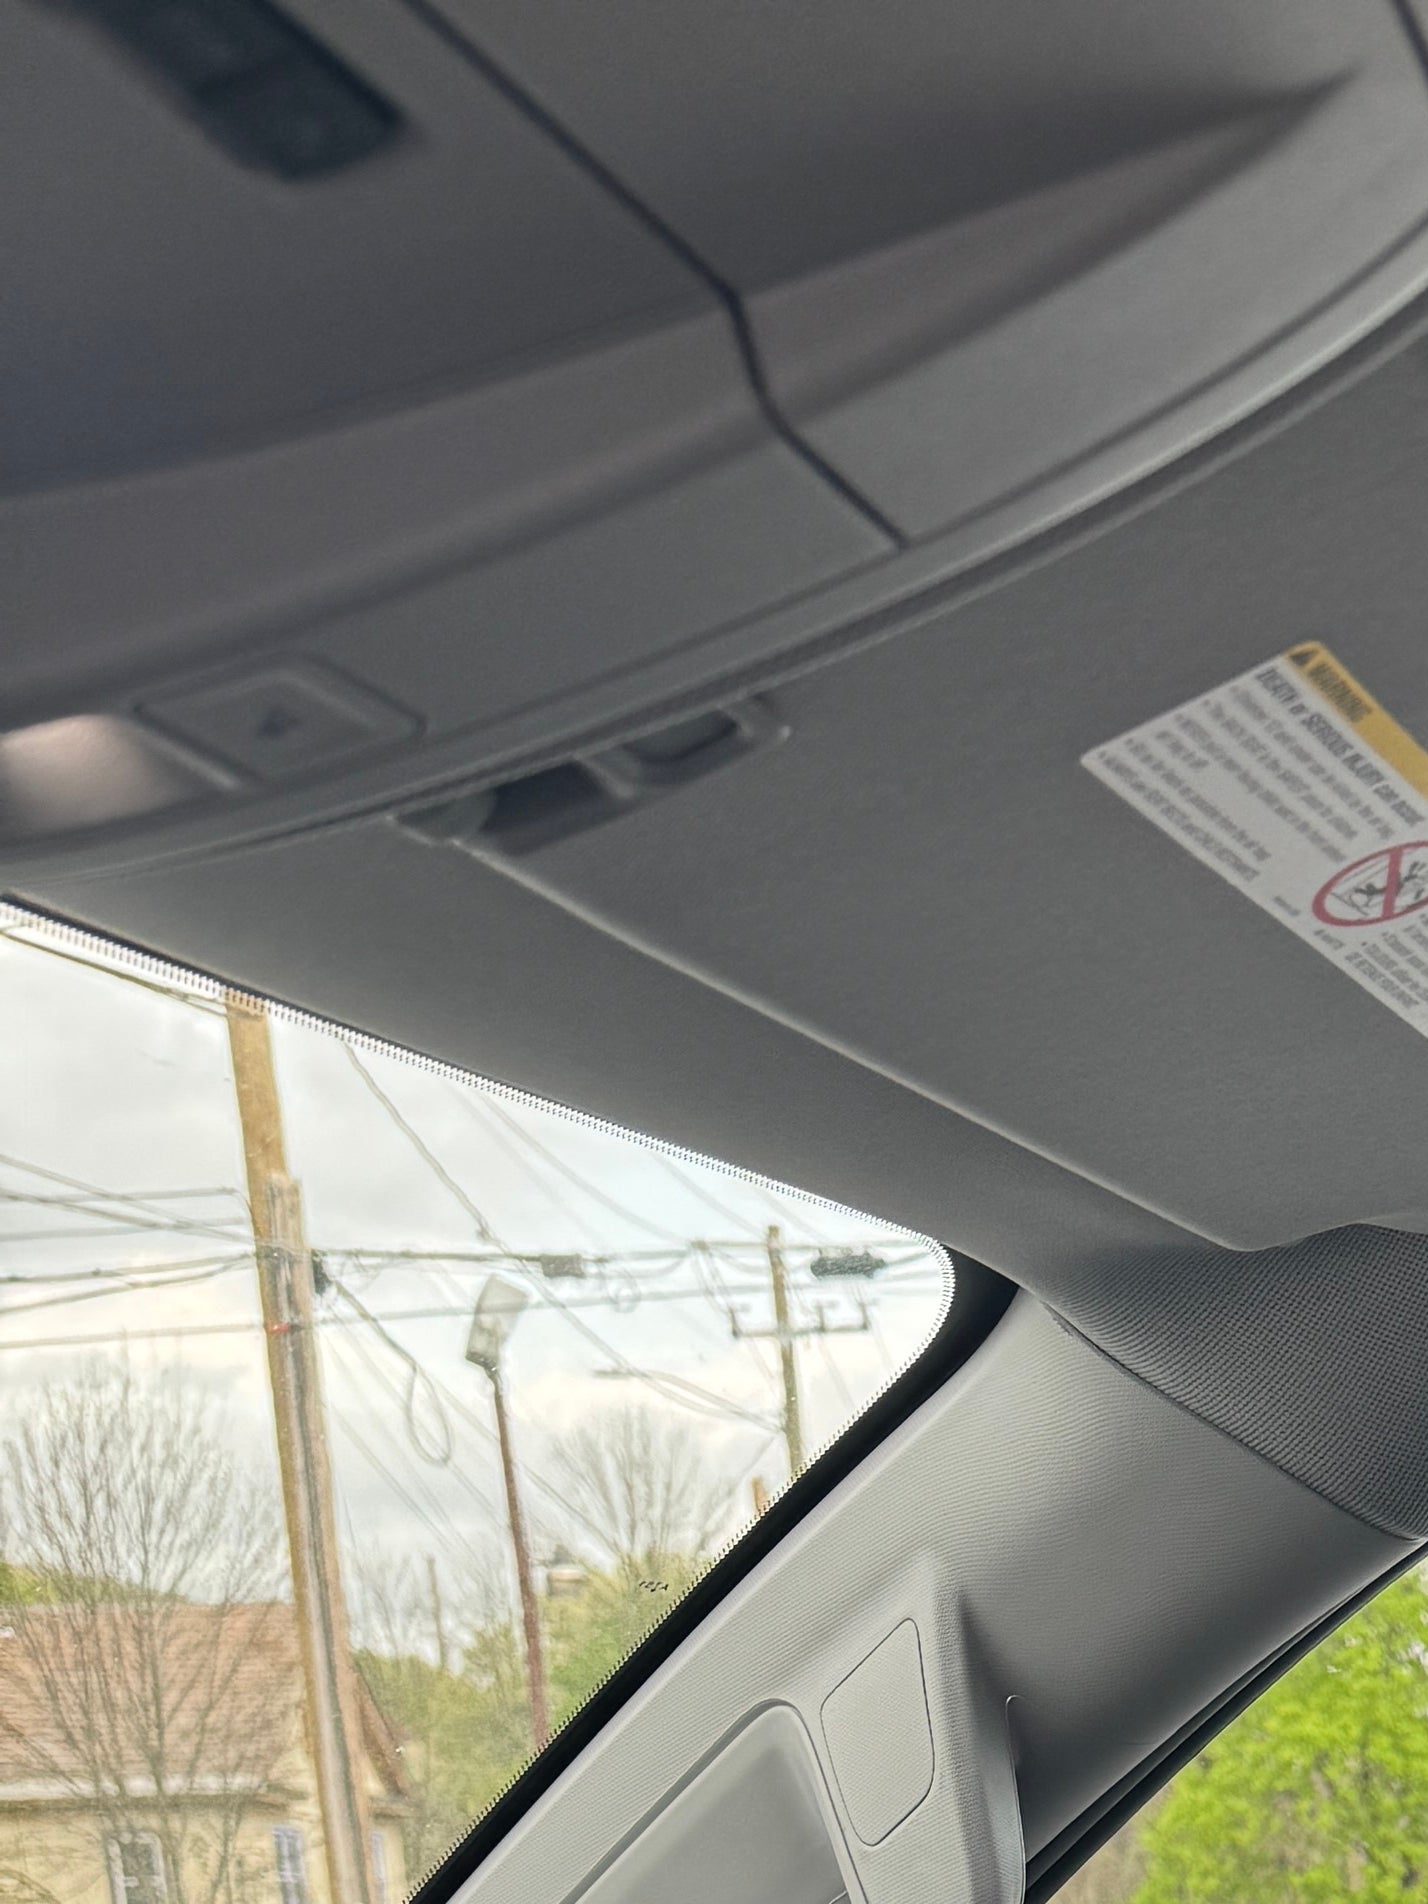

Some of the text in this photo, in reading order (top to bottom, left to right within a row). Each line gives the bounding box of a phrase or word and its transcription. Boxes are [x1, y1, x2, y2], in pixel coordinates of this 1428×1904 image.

[1255, 668, 1299, 703] DEATH
[1300, 713, 1354, 756] SERIOUS
[1304, 662, 1373, 721] WARNING
